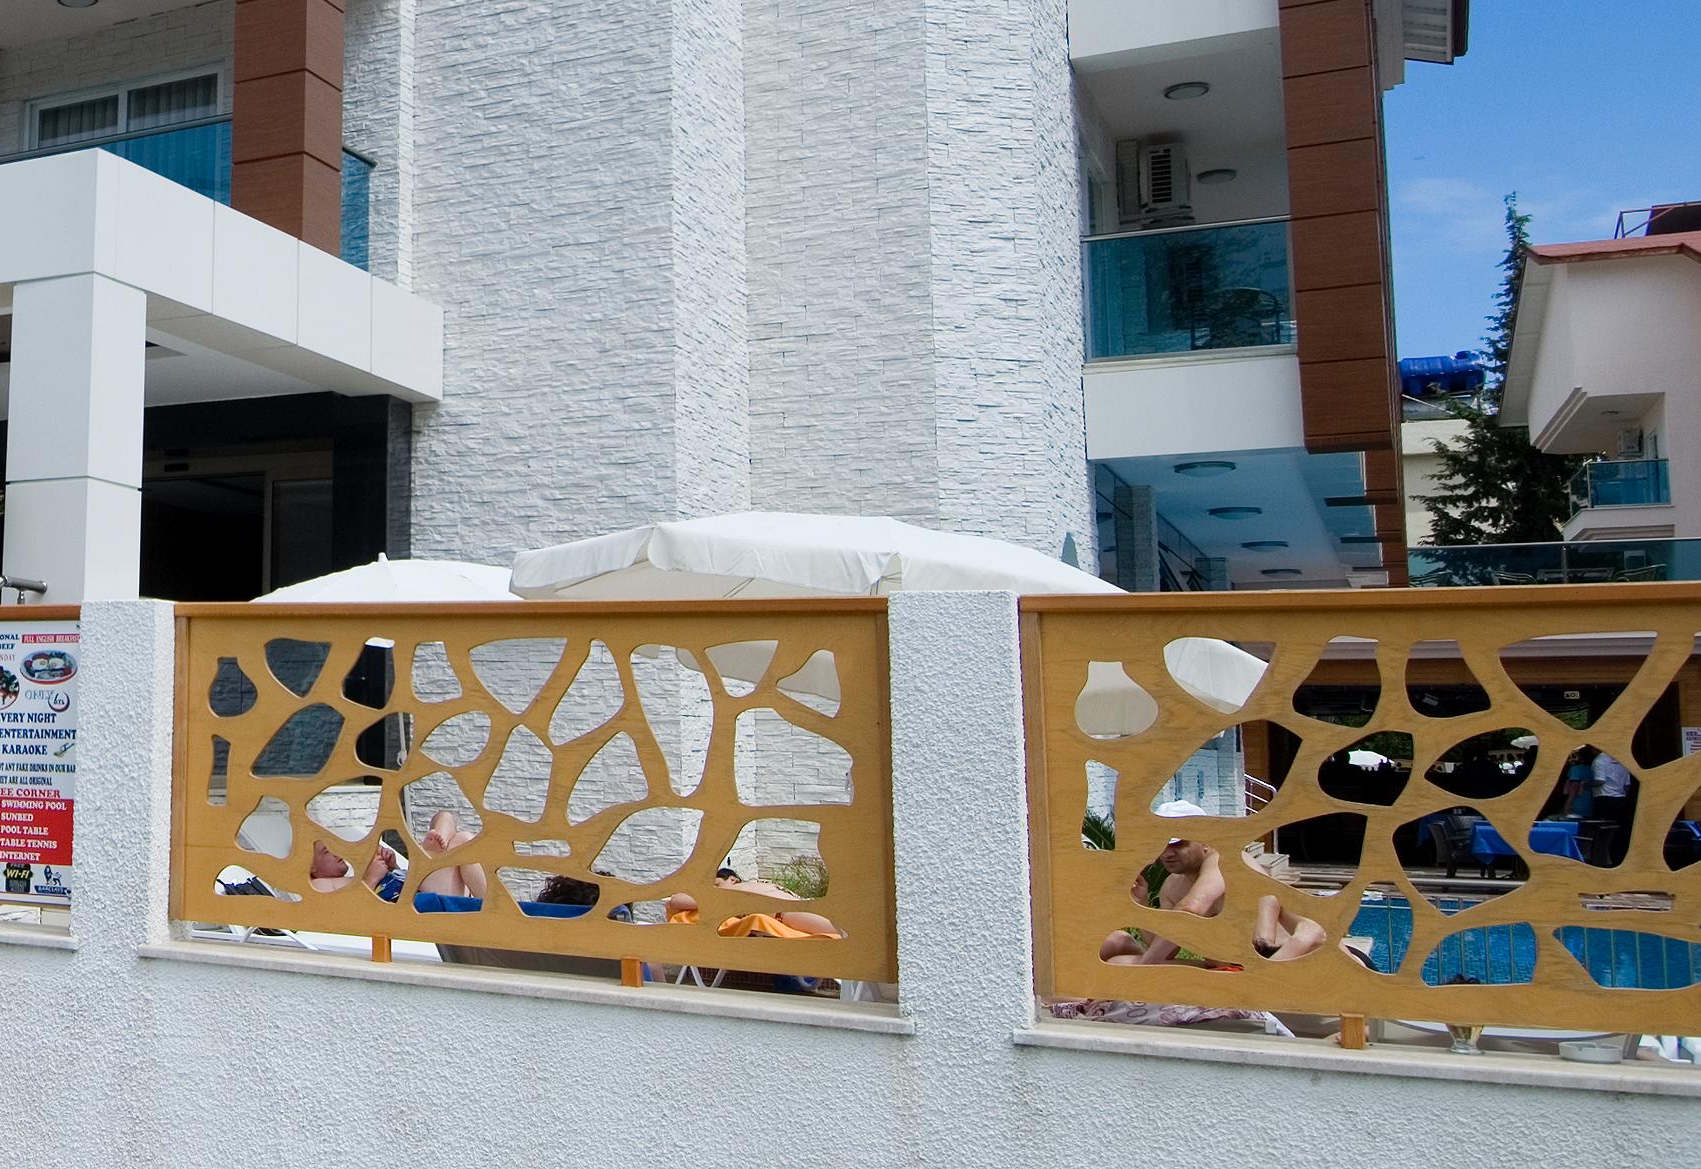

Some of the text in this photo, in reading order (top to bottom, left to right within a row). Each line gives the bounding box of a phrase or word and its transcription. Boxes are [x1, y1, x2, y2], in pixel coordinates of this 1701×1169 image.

[27, 713, 57, 723] NIGHT
[2, 744, 48, 755] KARAOKE
[5, 763, 15, 771] ANY
[16, 763, 28, 771] FAKE
[30, 764, 47, 772] DRINKS
[49, 764, 54, 772] IN
[55, 764, 65, 772] OUR
[20, 777, 28, 785] ALL
[29, 777, 52, 785] ORIGINAL
[16, 788, 60, 798] CORNER
[1, 800, 43, 809] SWIMMING
[45, 802, 67, 811] POOL
[1, 813, 34, 821] SUNBED
[1, 826, 21, 834] POOL
[23, 827, 49, 835] TABLE
[0, 838, 25, 847] TABLE
[27, 840, 57, 849] TENNIS
[0, 851, 41, 860] INTERNET
[6, 869, 30, 878] WI-FI
